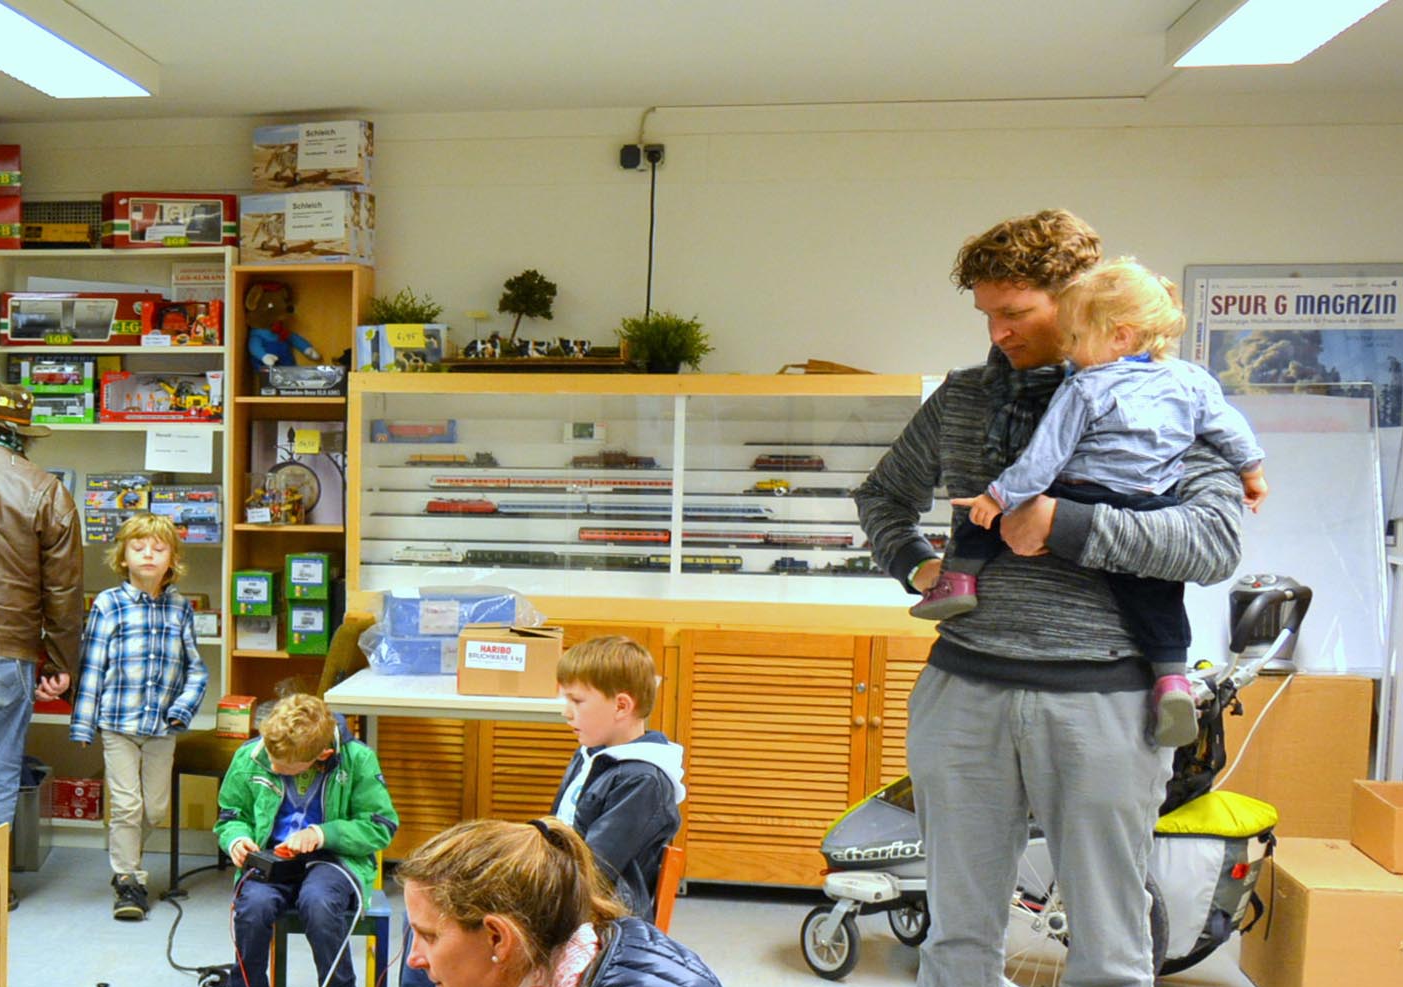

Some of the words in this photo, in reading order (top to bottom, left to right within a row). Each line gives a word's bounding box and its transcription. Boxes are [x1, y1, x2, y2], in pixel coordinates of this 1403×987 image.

[305, 129, 336, 137] Schleich
[292, 202, 323, 210] Schleich
[1210, 294, 1267, 316] SPUR
[1274, 294, 1288, 316] G
[1295, 293, 1397, 316] MAGAZIN
[480, 644, 512, 655] HARIBO
